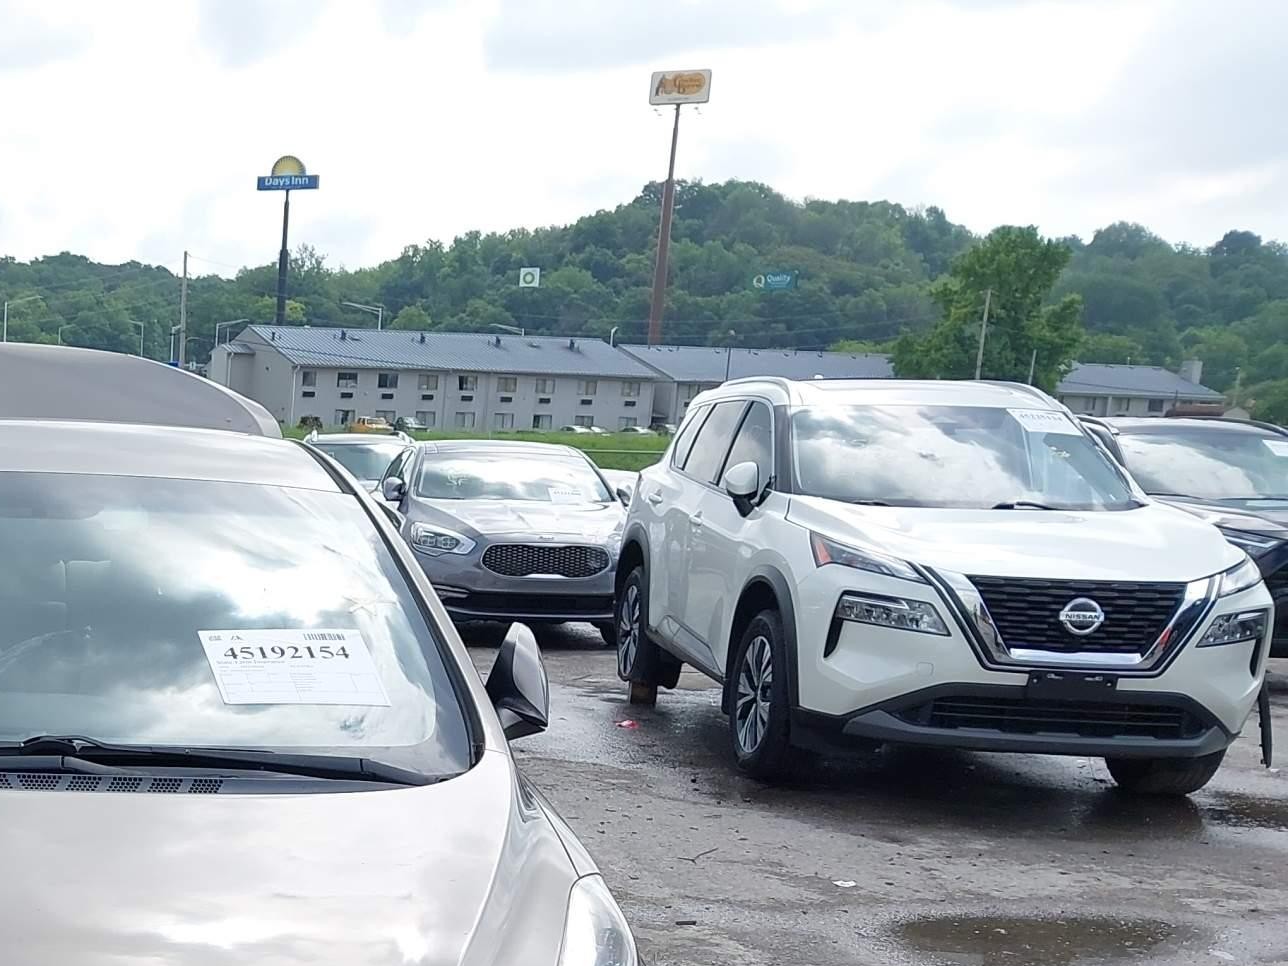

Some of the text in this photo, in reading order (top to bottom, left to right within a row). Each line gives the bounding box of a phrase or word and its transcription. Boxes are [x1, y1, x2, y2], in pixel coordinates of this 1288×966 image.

[264, 175, 309, 186] Days Inn
[223, 645, 350, 660] 45192154
